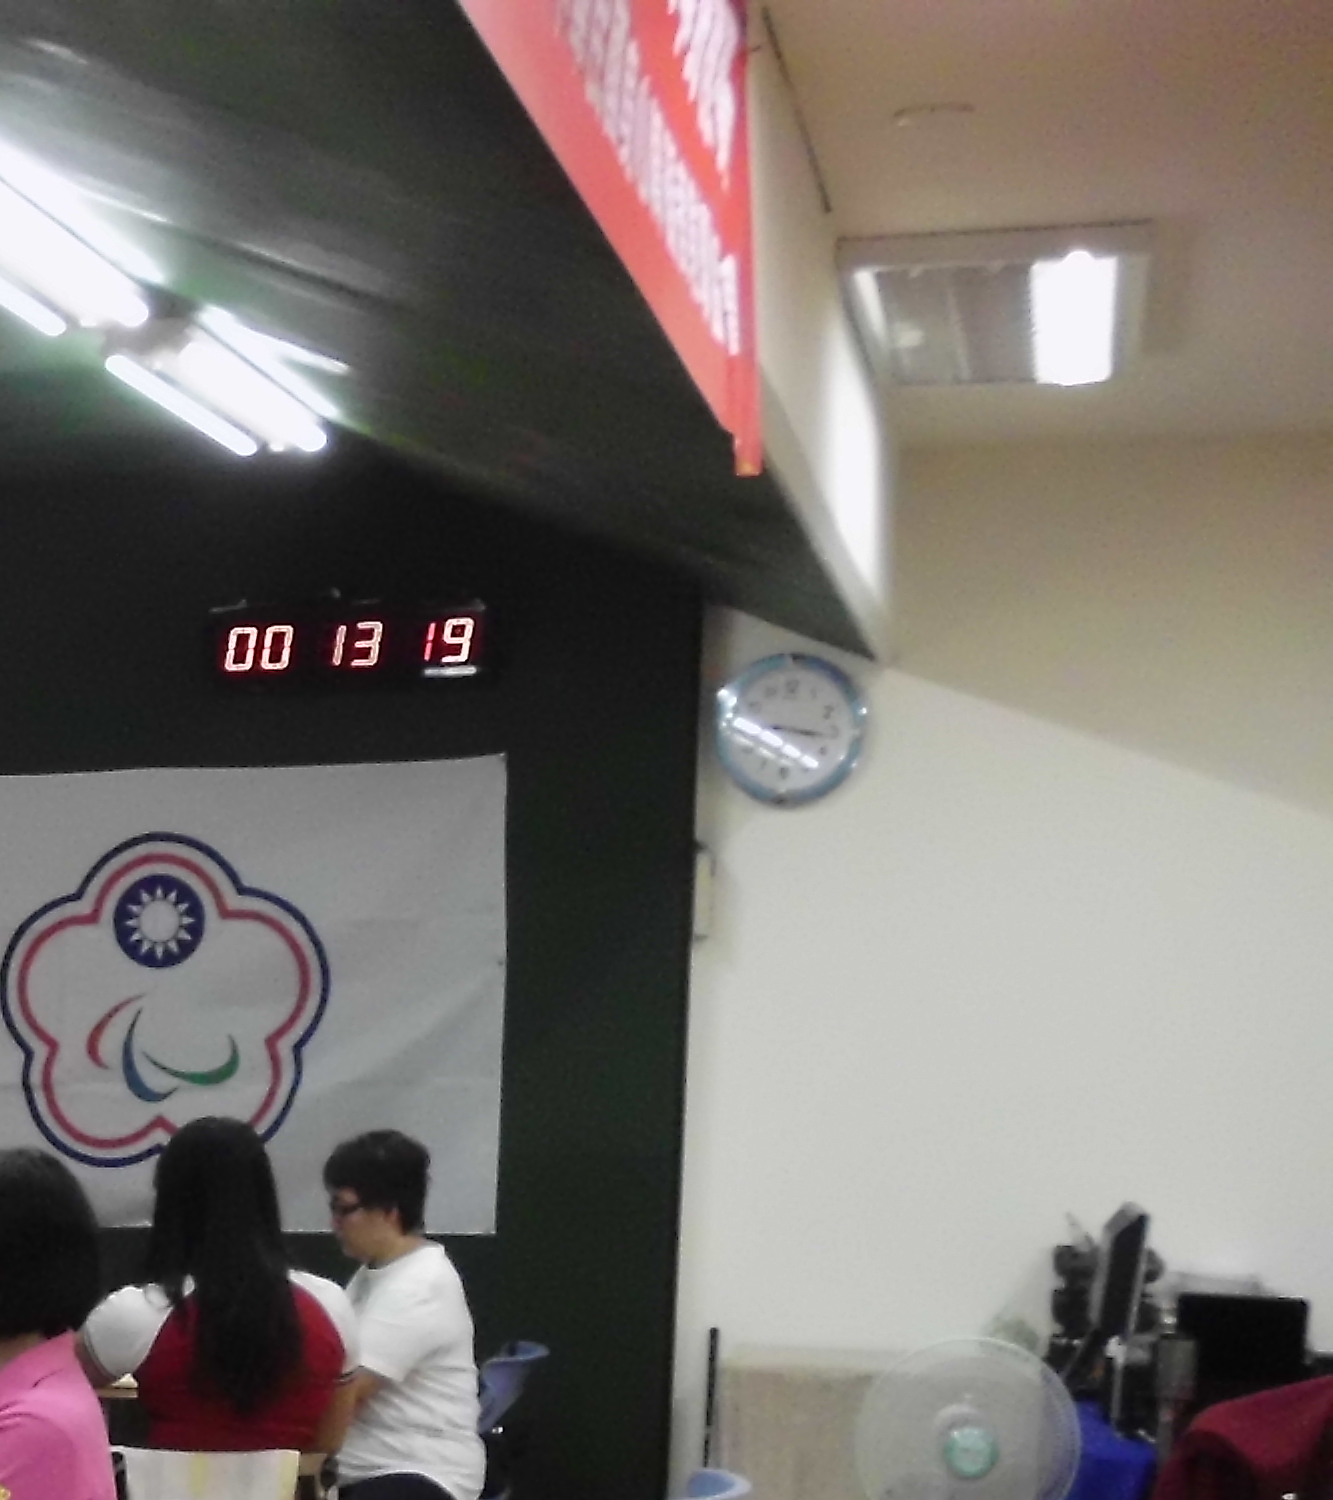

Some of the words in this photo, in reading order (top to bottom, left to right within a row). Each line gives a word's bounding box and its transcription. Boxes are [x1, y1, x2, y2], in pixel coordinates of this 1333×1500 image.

[224, 625, 294, 672] 00
[332, 621, 383, 667] 13
[424, 616, 475, 663] 19
